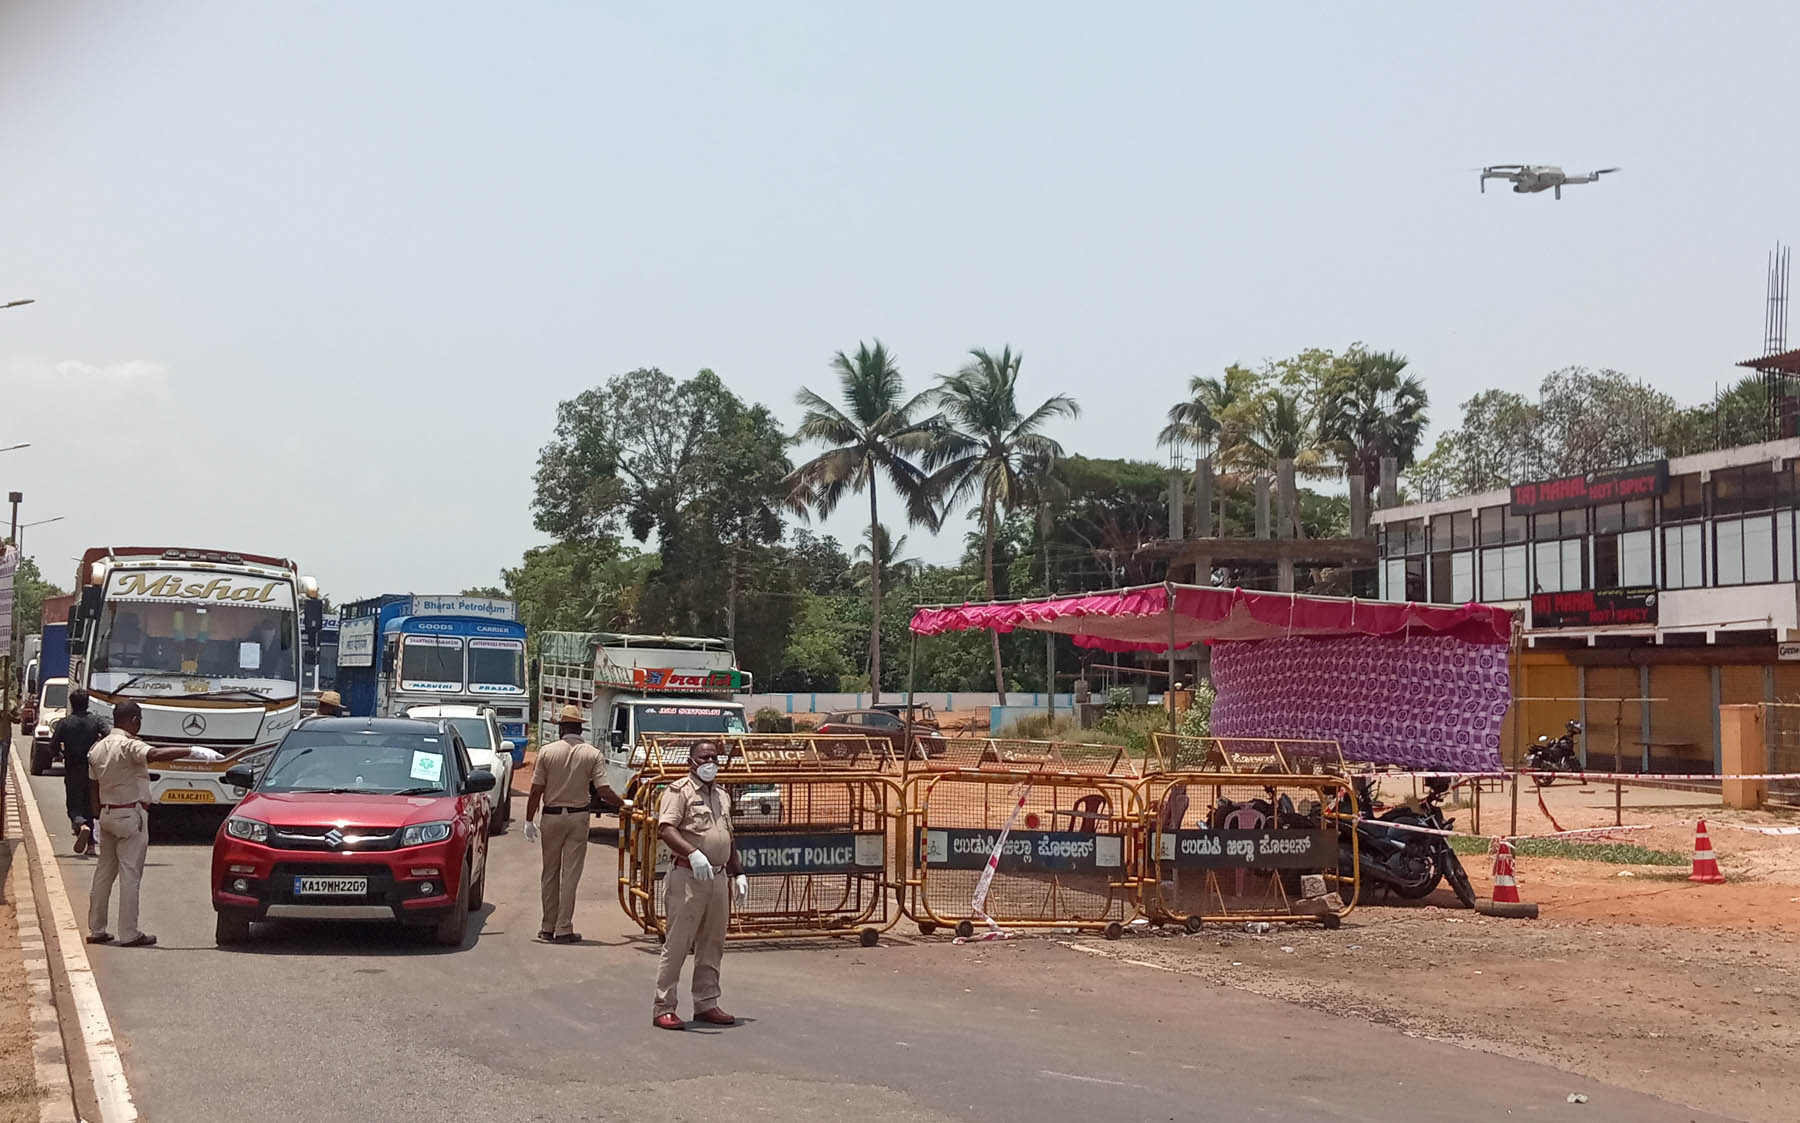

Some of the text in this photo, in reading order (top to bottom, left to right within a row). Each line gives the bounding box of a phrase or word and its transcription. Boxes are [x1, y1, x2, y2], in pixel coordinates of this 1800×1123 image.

[1540, 477, 1587, 501] MAHAL
[1589, 484, 1613, 499] HOT
[1620, 475, 1657, 495] SPICY
[112, 573, 284, 603] Mishal
[424, 601, 505, 614] Bharat Petroleum
[418, 623, 510, 633] GOODS CARRIER
[142, 682, 172, 691] INDIA
[750, 750, 807, 761] POLICE
[1181, 834, 1222, 856] ಉಡುಪಿ
[804, 846, 853, 866] POLICE
[302, 880, 366, 892] KA19MH2209
